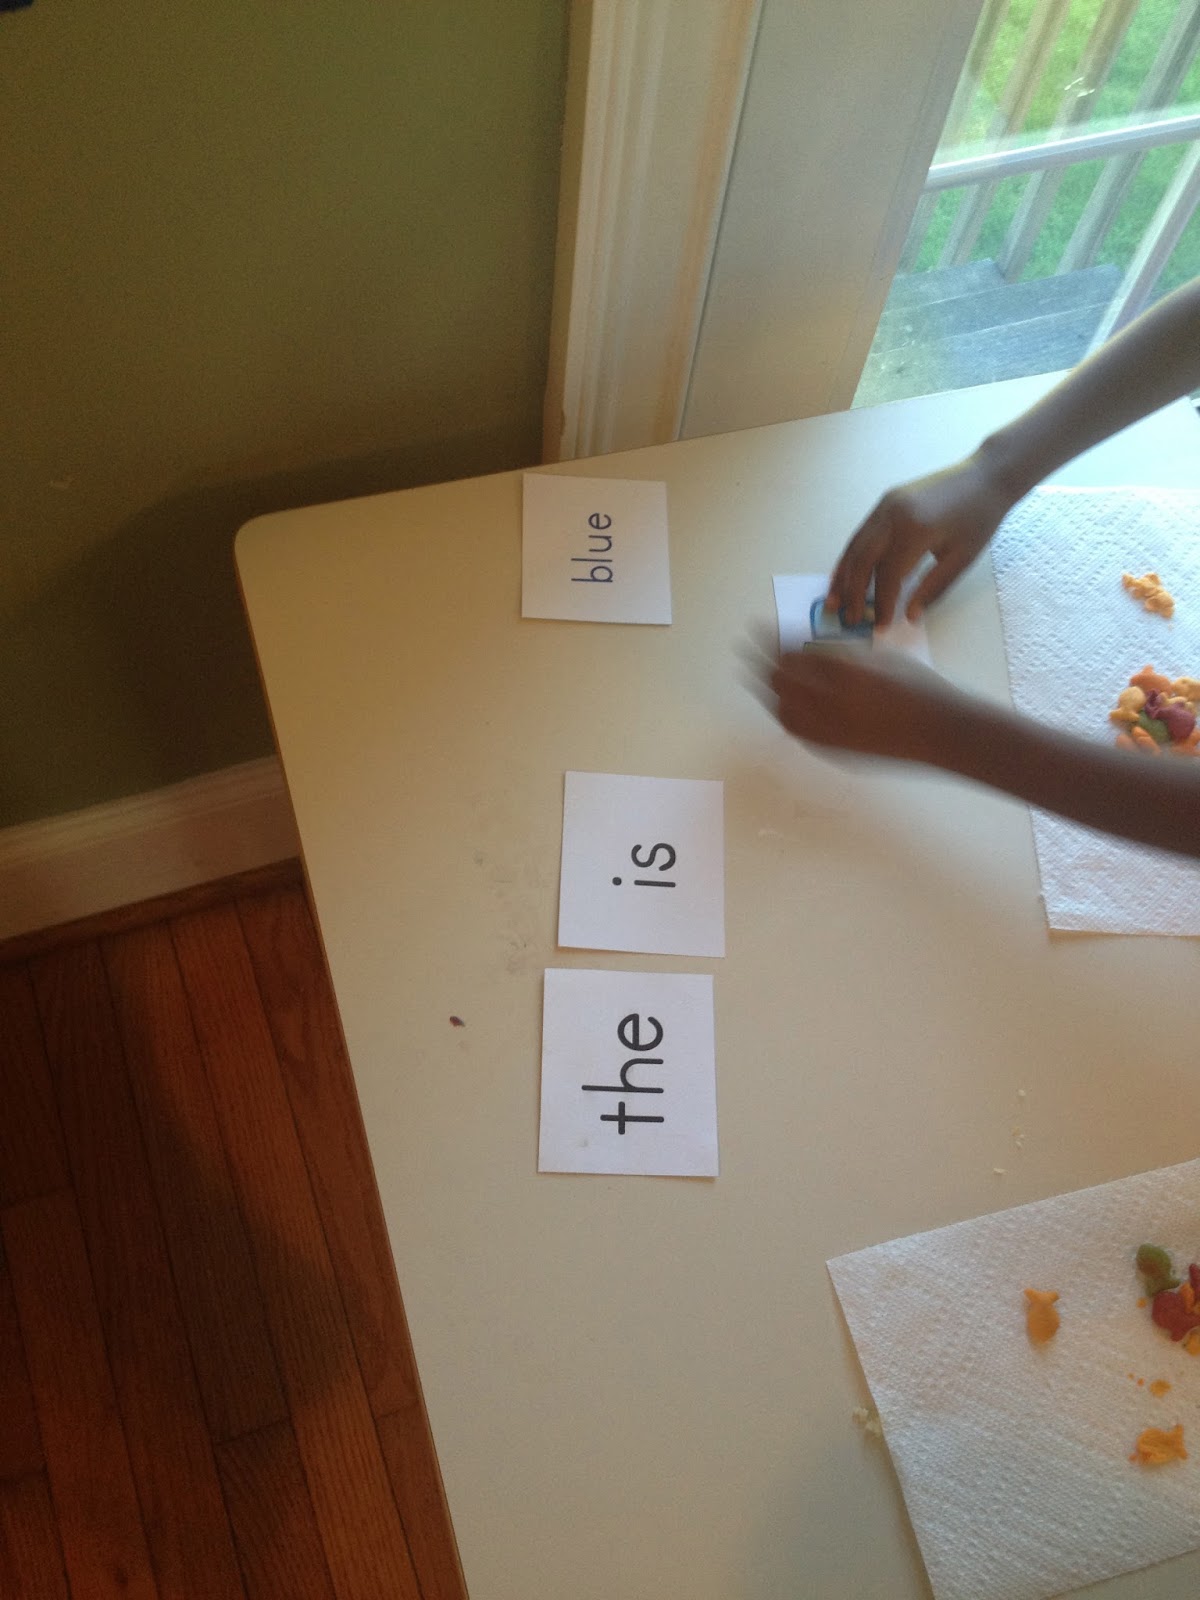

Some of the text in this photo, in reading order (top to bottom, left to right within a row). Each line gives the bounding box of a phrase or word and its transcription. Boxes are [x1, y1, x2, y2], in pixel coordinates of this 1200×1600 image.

[570, 511, 613, 584] blue
[612, 842, 677, 888] is
[581, 1012, 665, 1136] the
